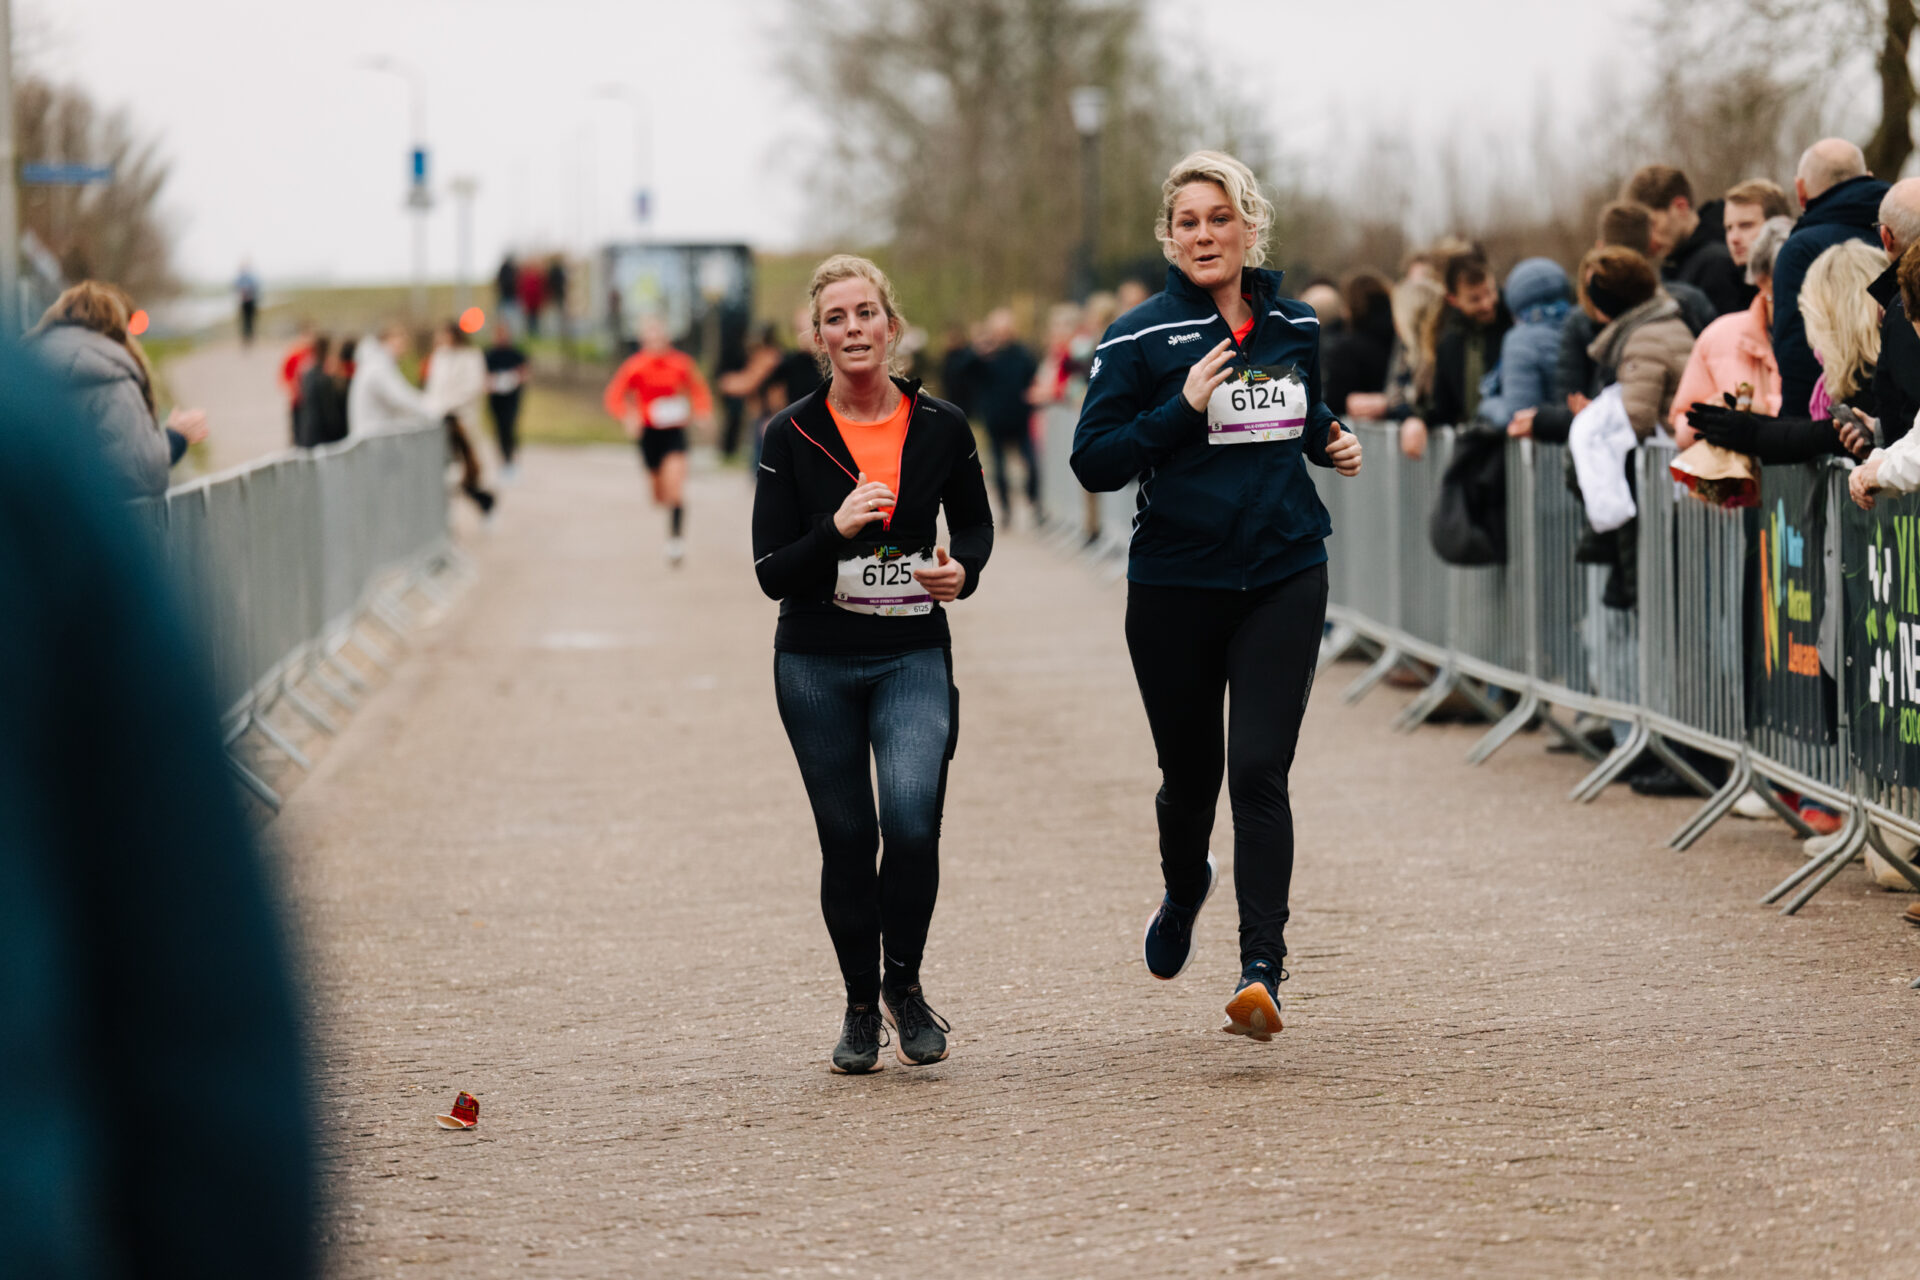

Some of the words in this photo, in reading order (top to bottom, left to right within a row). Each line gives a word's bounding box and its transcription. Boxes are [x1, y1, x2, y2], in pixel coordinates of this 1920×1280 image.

[1176, 332, 1201, 343] Reece
[1231, 386, 1286, 412] 6124
[862, 562, 912, 586] 6125
[1893, 515, 1920, 615] YA
[913, 604, 930, 613] 6125
